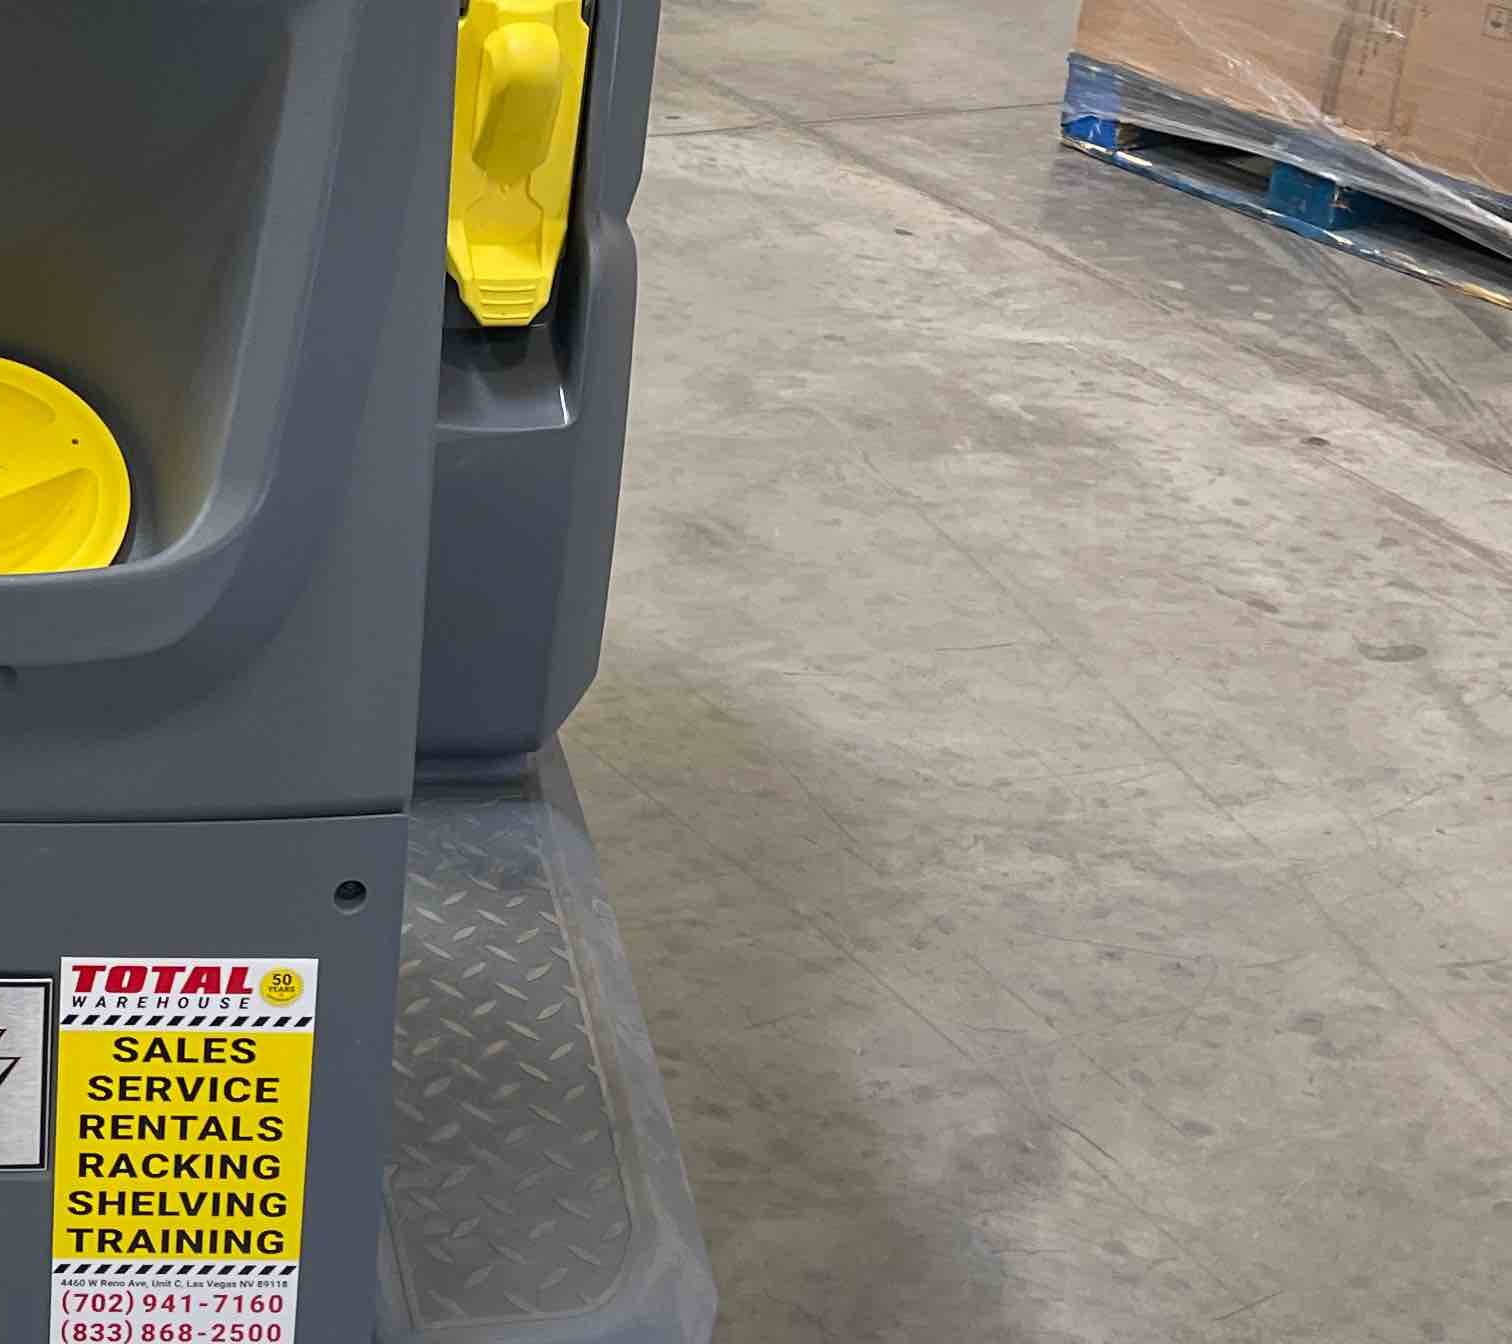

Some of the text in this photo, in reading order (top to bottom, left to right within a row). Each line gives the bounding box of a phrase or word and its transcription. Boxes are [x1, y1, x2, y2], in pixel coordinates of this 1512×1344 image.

[71, 965, 292, 994] TOTAL 50
[72, 996, 251, 1009] WAREHOUSE
[112, 1036, 257, 1064] SALES
[87, 1076, 280, 1103] SERVICE
[78, 1114, 284, 1142] RENTALS
[77, 1153, 281, 1180] RACKING
[67, 1191, 287, 1218] SHELVING
[66, 1228, 285, 1255] TRAINING
[60, 1279, 85, 1288] 4460
[88, 1279, 98, 1287] W
[101, 1279, 125, 1287] Reno
[152, 1279, 171, 1288] Unit
[187, 1280, 204, 1288] Las
[207, 1280, 237, 1289] Vegas
[240, 1280, 254, 1288] NV
[62, 1290, 283, 1316] (702) 941-7160
[61, 1320, 281, 1344] (833) 868-2500
